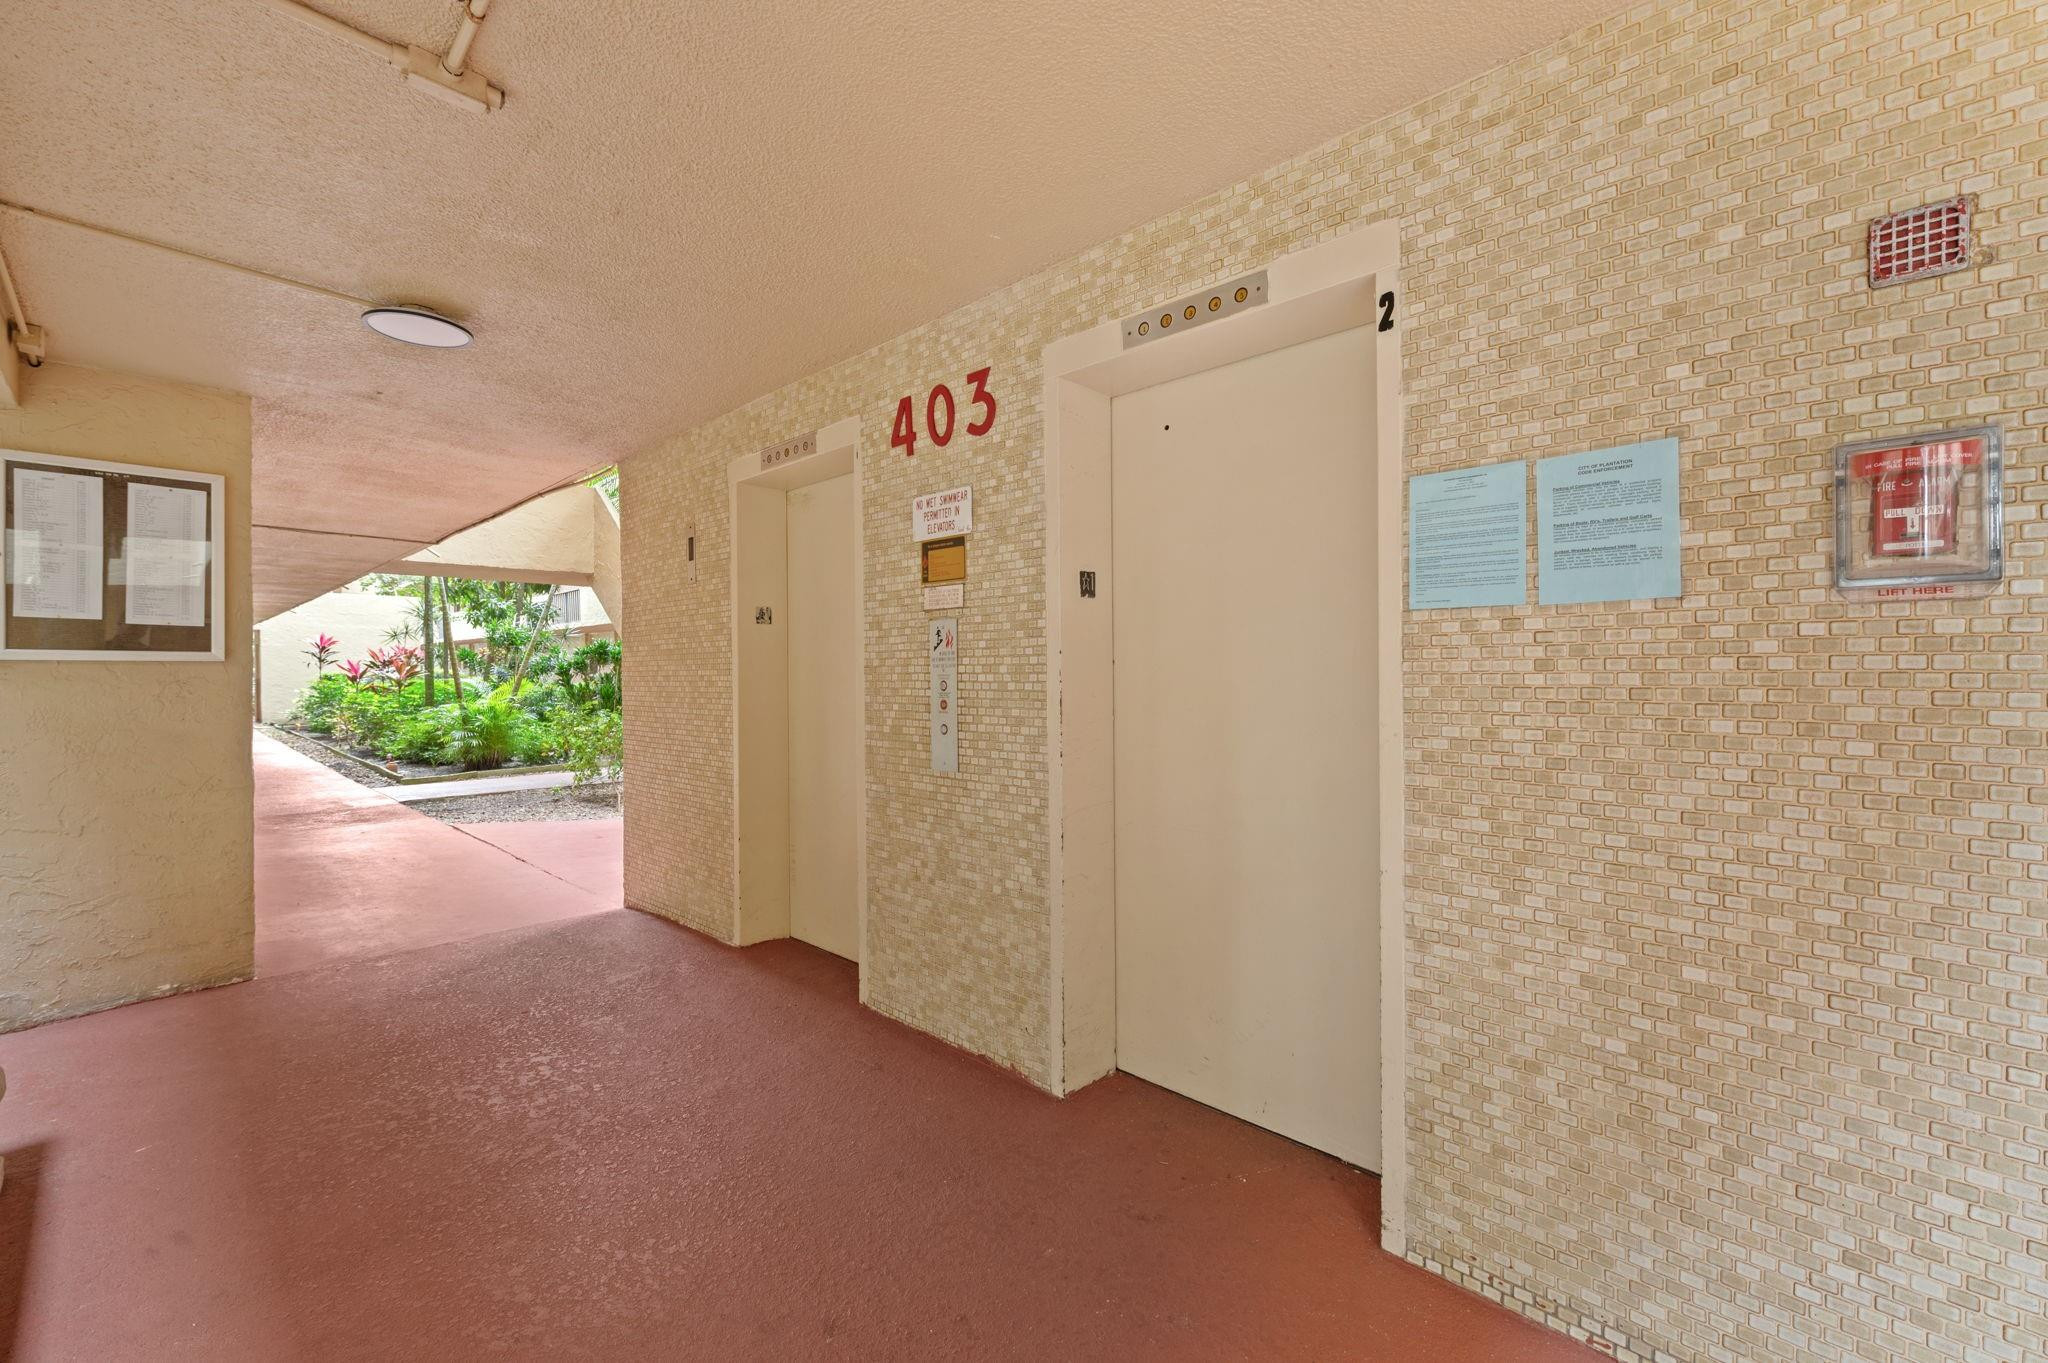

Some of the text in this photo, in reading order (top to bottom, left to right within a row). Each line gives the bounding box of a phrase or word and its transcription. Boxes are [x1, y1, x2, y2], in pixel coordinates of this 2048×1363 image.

[1378, 290, 1395, 332] 2
[890, 366, 997, 457] 403
[1593, 463, 1633, 473] ENFORCEMENT
[1599, 459, 1633, 468] PLANTATION
[1877, 476, 1951, 492] FIRE AARM
[915, 489, 968, 511] NO WET SWIMWEAR
[923, 504, 961, 522] PERMITTED IN
[1885, 509, 1905, 517] PULL
[927, 519, 956, 535] ELEVATORS
[1877, 586, 1954, 597] LIFT HERE
